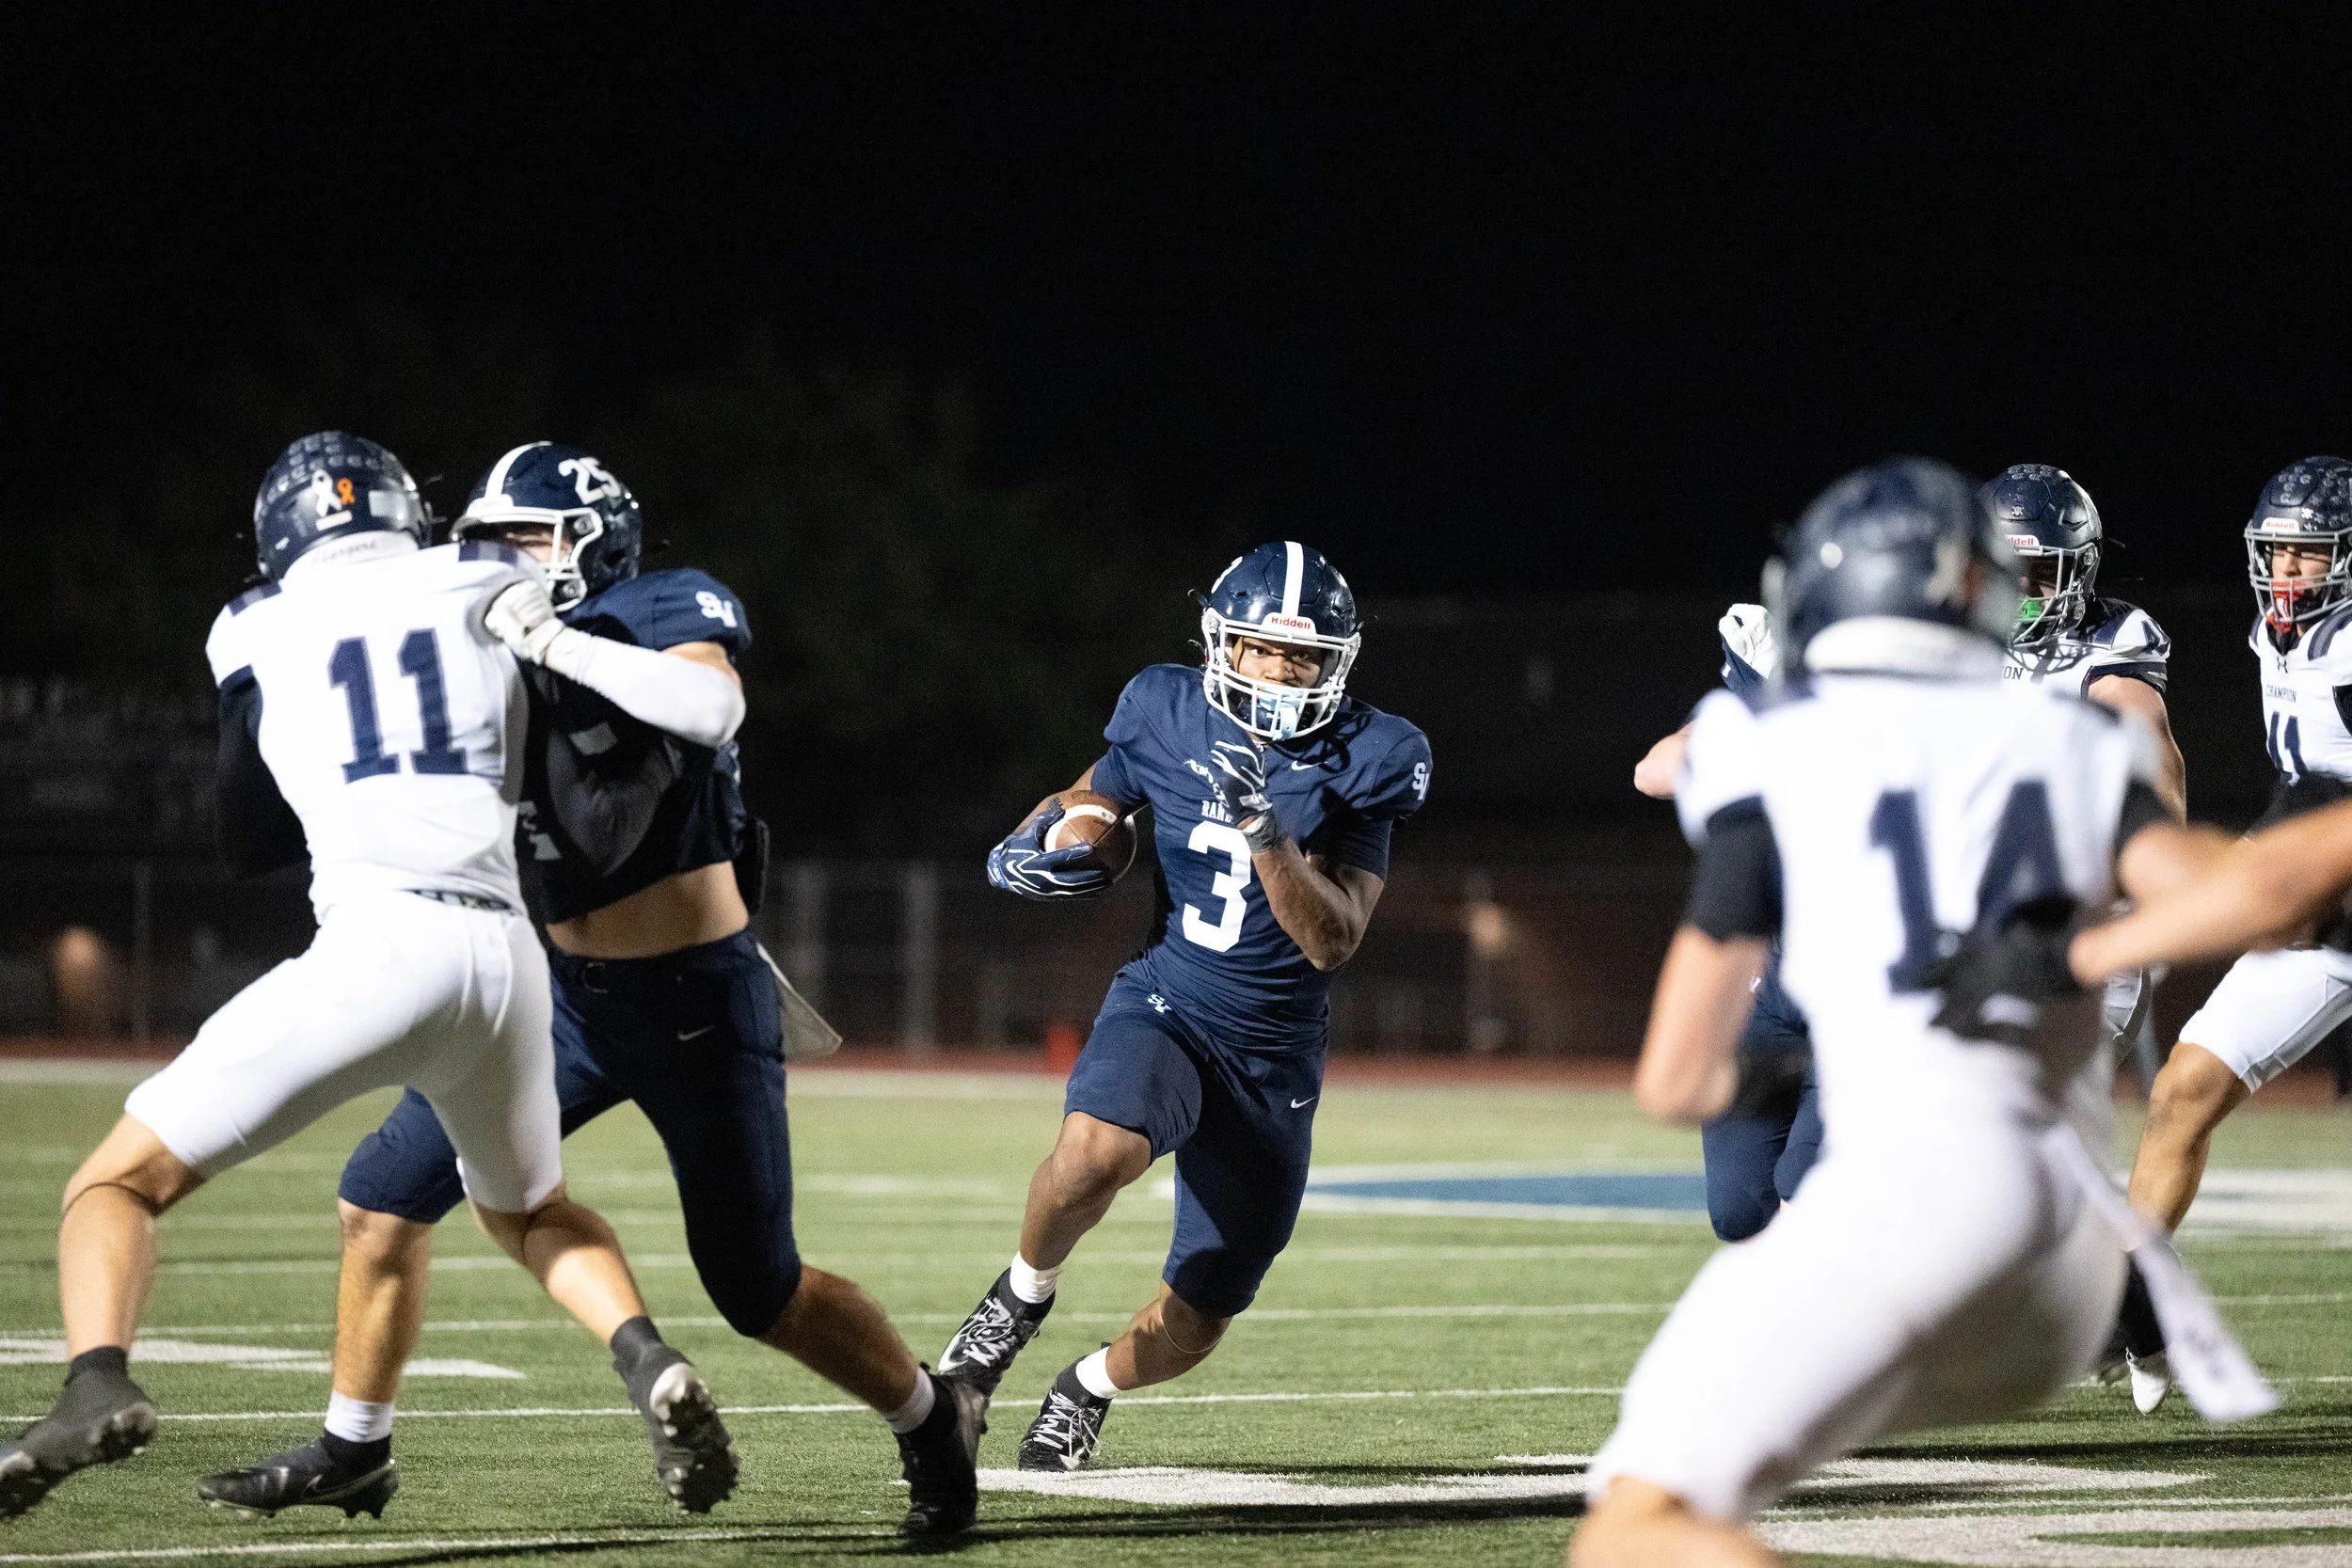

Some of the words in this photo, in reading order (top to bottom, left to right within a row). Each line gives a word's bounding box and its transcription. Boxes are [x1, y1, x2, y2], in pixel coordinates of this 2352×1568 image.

[558, 457, 622, 505] 25
[1271, 616, 1311, 629] Riddell
[327, 627, 468, 784] 11
[1183, 820, 1252, 953] 3
[1867, 777, 2074, 993] 14
